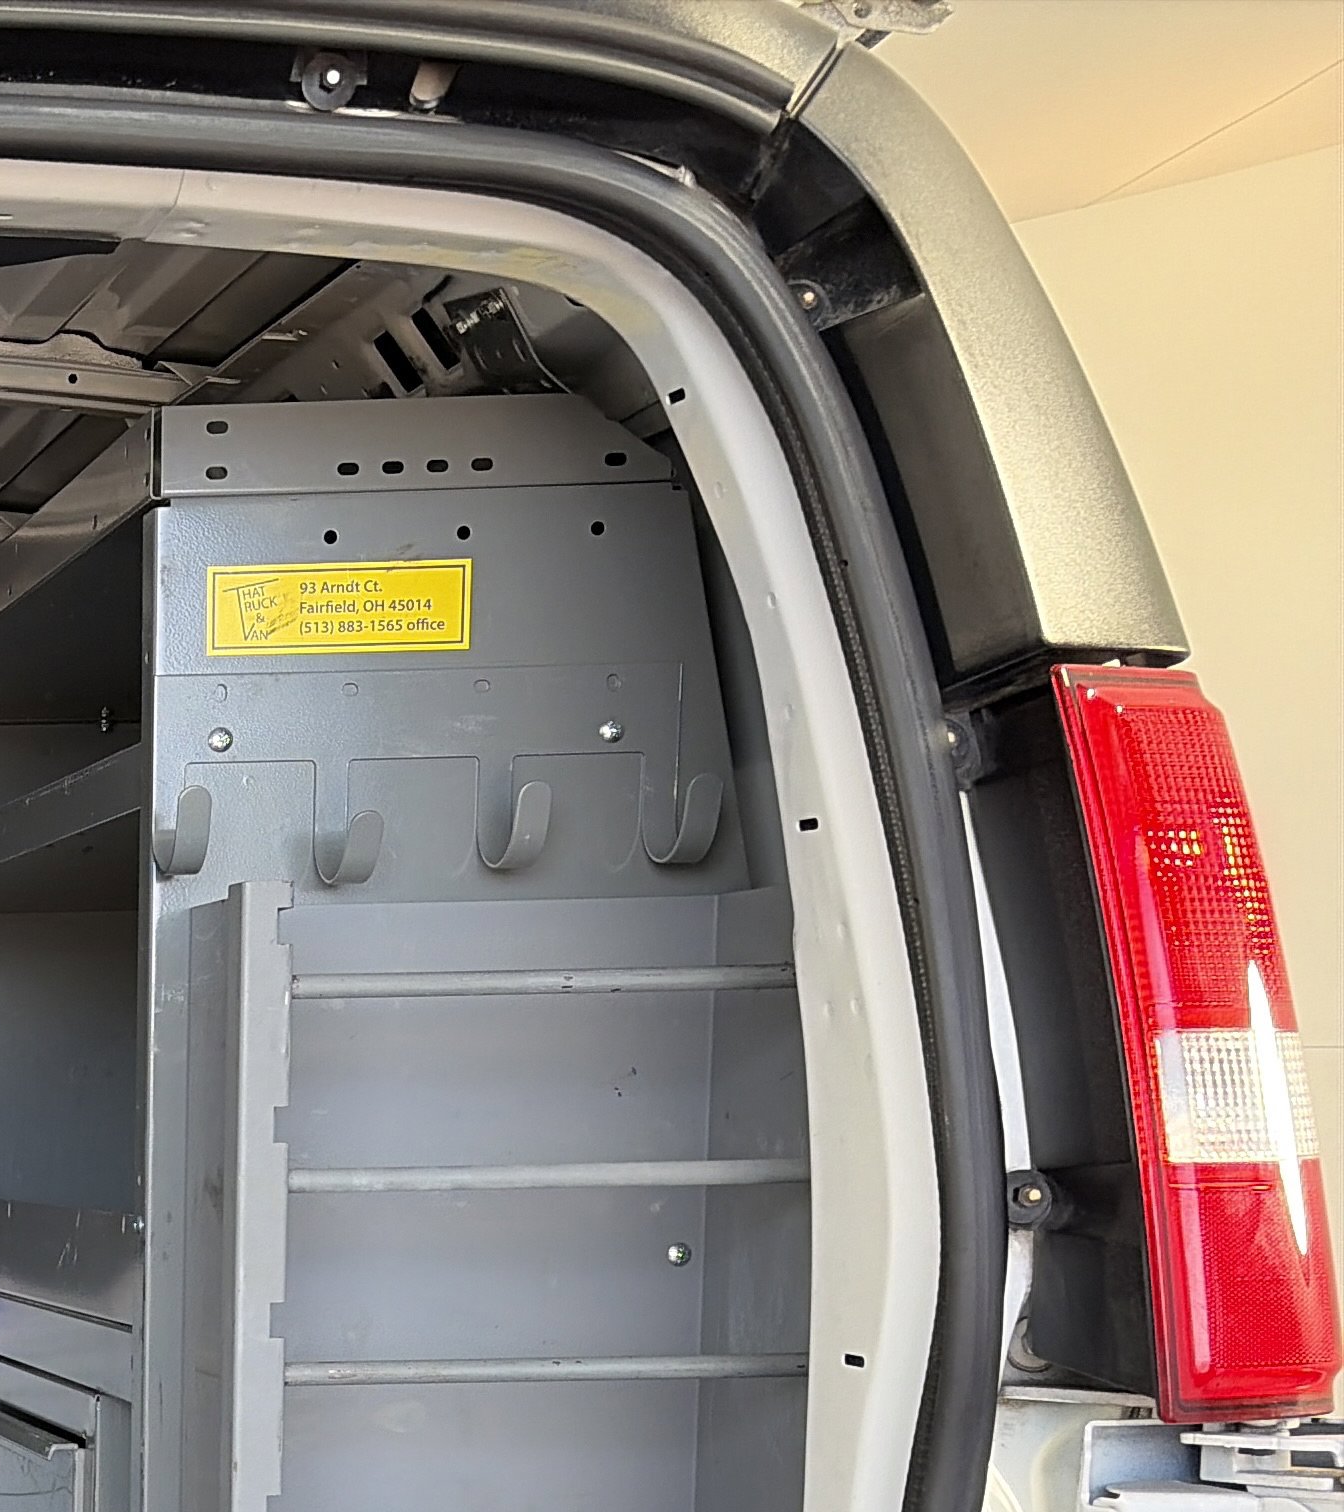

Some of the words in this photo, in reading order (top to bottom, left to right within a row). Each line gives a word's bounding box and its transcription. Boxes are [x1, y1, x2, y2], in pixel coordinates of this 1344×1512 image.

[299, 582, 316, 595] 93
[320, 580, 360, 593] Arndt
[364, 579, 383, 592] Ct.
[299, 599, 359, 614] Fairfield,
[363, 599, 385, 613] OH
[388, 598, 432, 612] 45014
[256, 612, 265, 624] &
[299, 620, 334, 636] (513)
[337, 619, 403, 633] 883-1565
[407, 618, 445, 632] office
